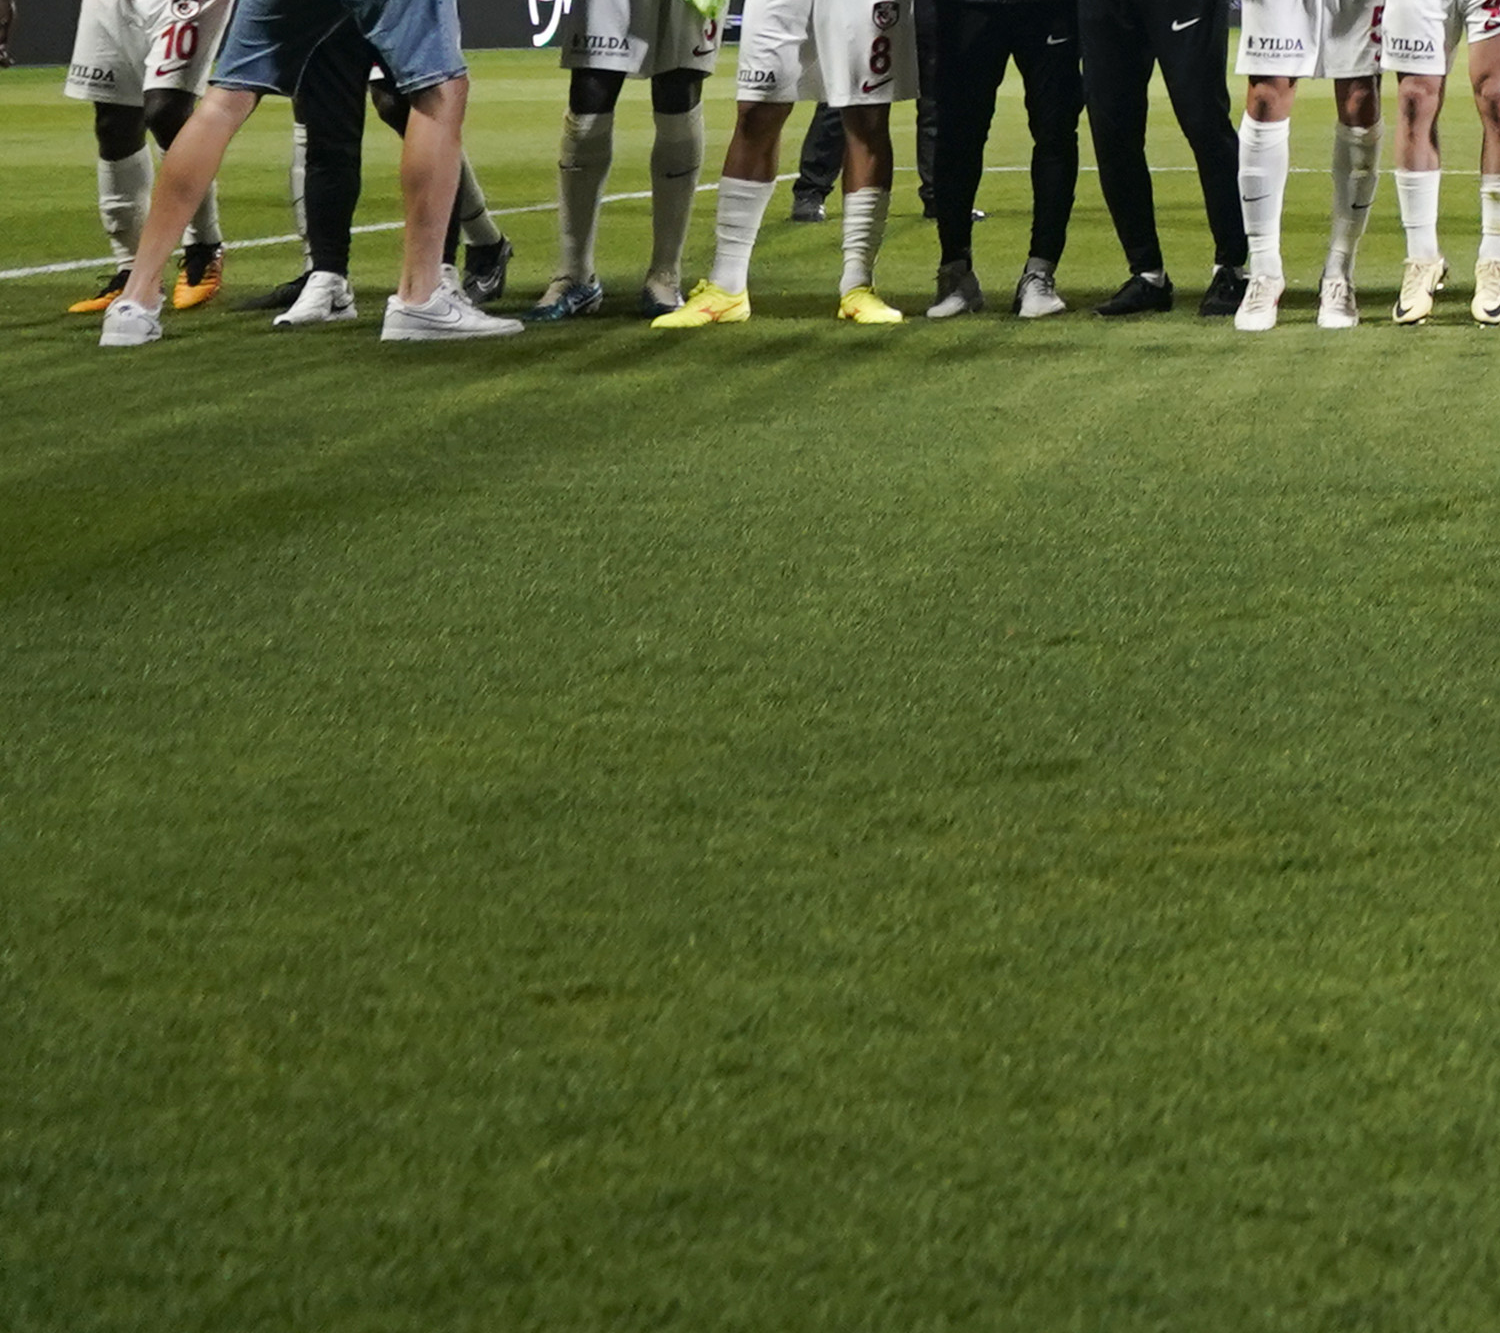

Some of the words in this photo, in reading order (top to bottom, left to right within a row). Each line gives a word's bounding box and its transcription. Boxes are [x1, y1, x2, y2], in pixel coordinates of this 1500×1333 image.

[160, 23, 199, 60] 10
[583, 36, 630, 51] YILDA
[1258, 37, 1304, 51] YILDA
[1391, 38, 1434, 52] YILDA
[869, 36, 892, 75] 8
